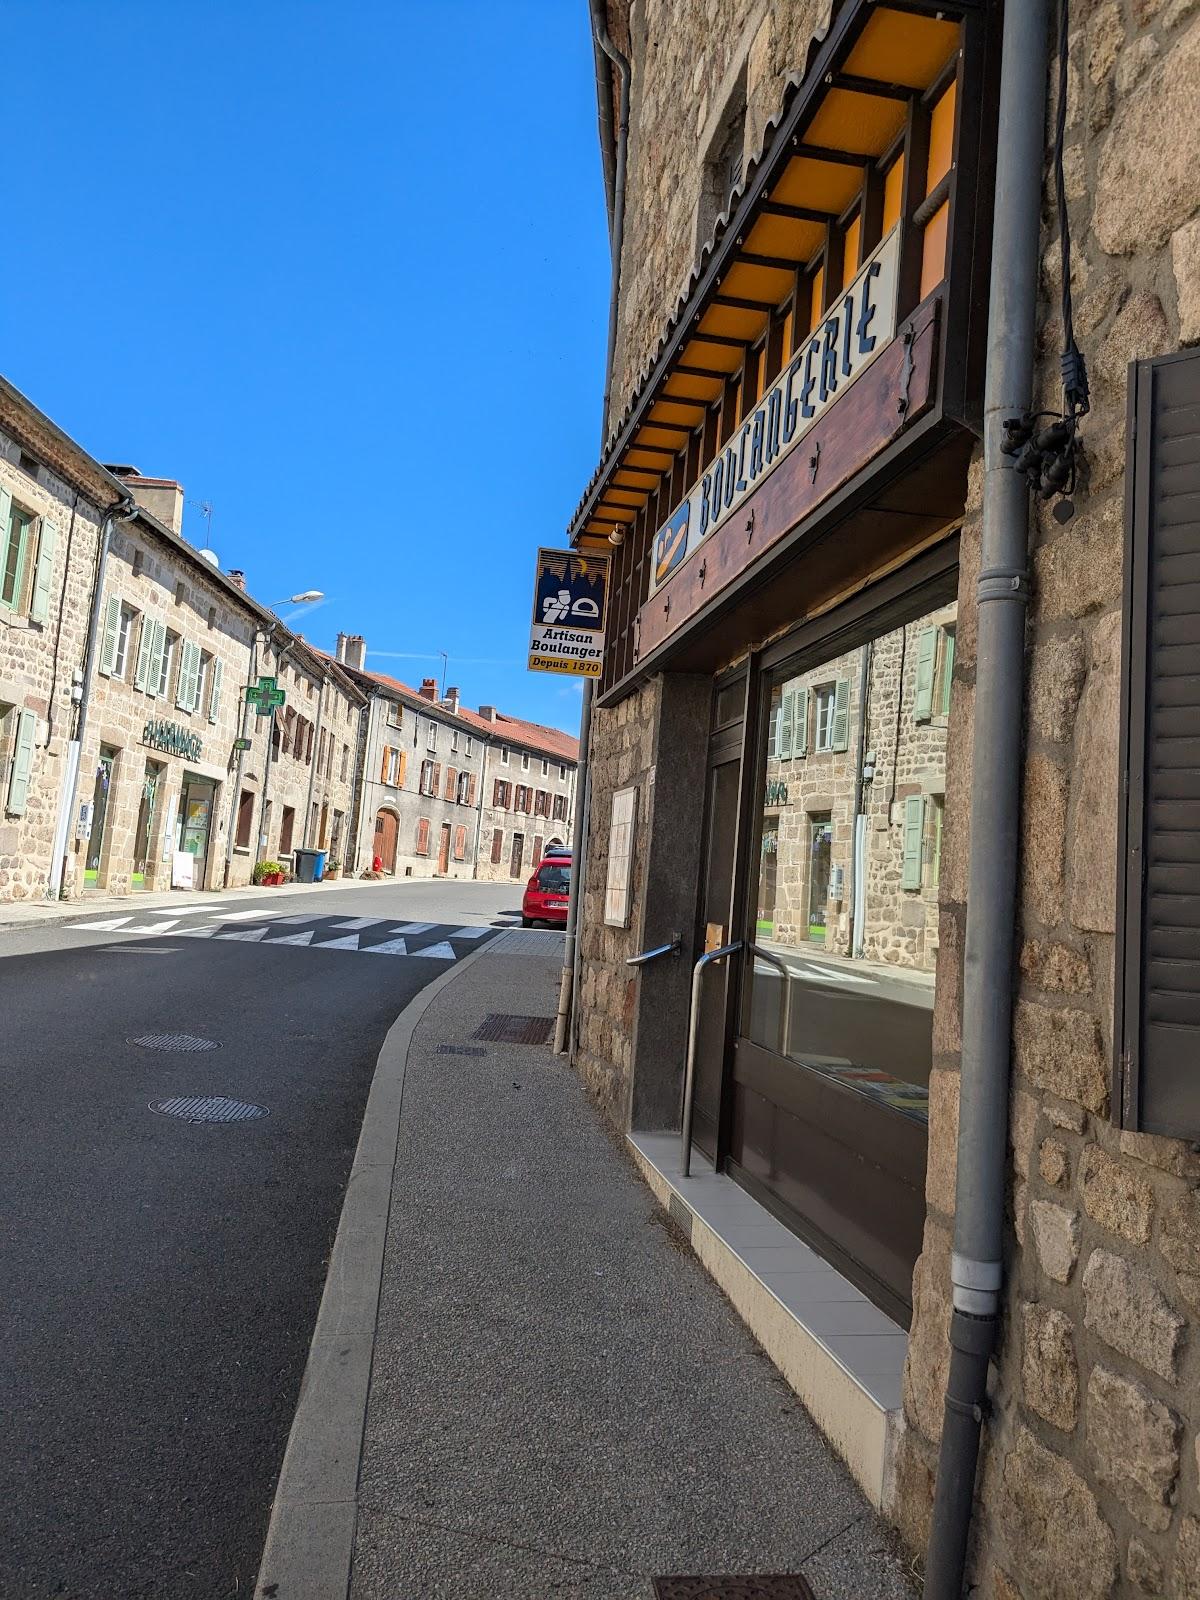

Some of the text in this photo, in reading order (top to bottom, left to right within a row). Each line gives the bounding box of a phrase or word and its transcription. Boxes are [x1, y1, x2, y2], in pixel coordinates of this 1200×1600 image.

[699, 261, 881, 536] BOULANGERIE
[542, 628, 593, 644] Artisan
[530, 640, 603, 658] Boulanger
[532, 657, 599, 672] Depuis 1870
